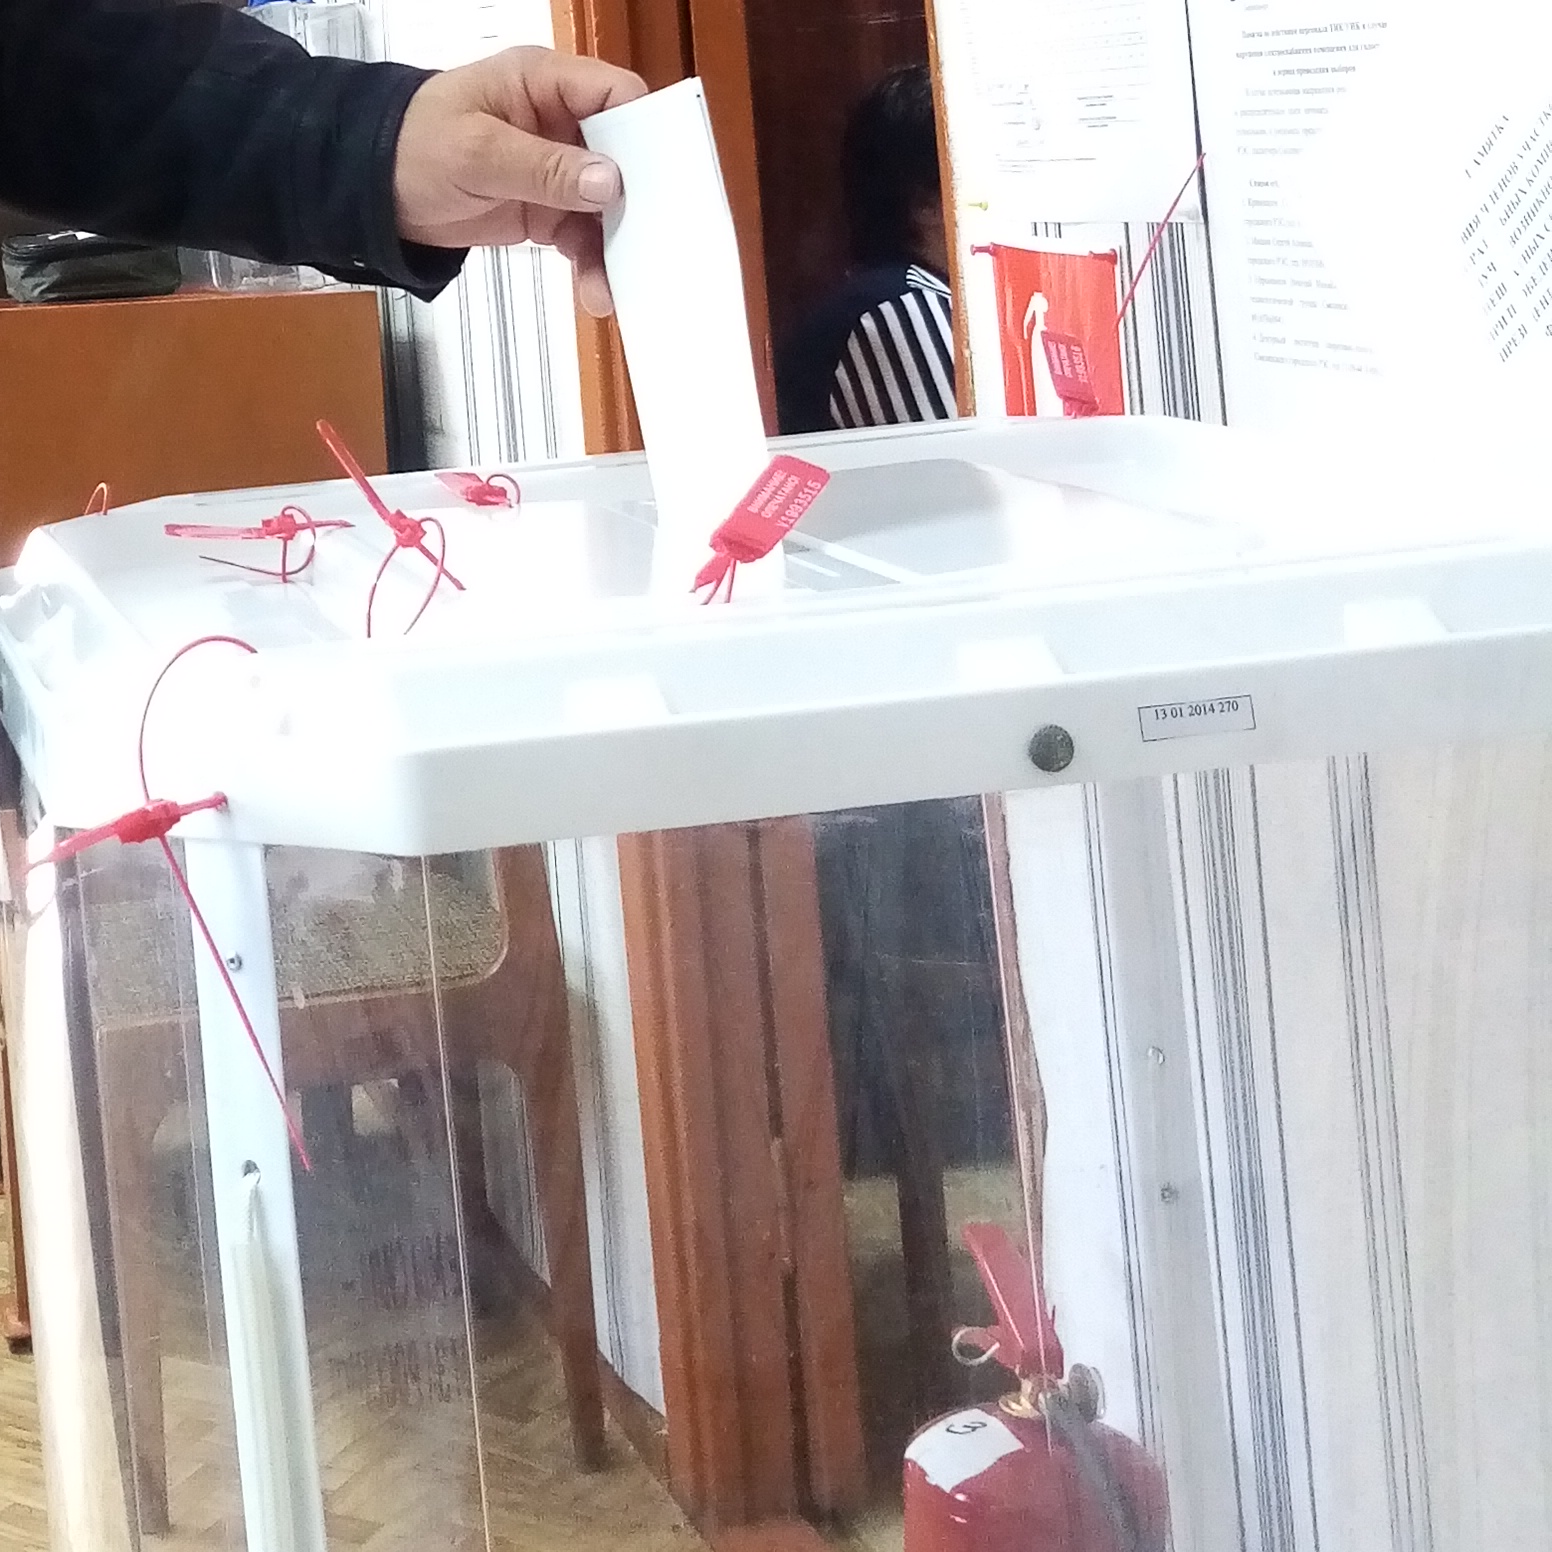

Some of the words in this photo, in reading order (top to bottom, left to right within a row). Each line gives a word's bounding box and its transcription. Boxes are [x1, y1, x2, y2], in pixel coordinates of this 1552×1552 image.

[1154, 708, 1167, 720] 13
[1170, 706, 1184, 719] 01
[1187, 703, 1216, 717] 2014
[1218, 699, 1239, 713] 270
